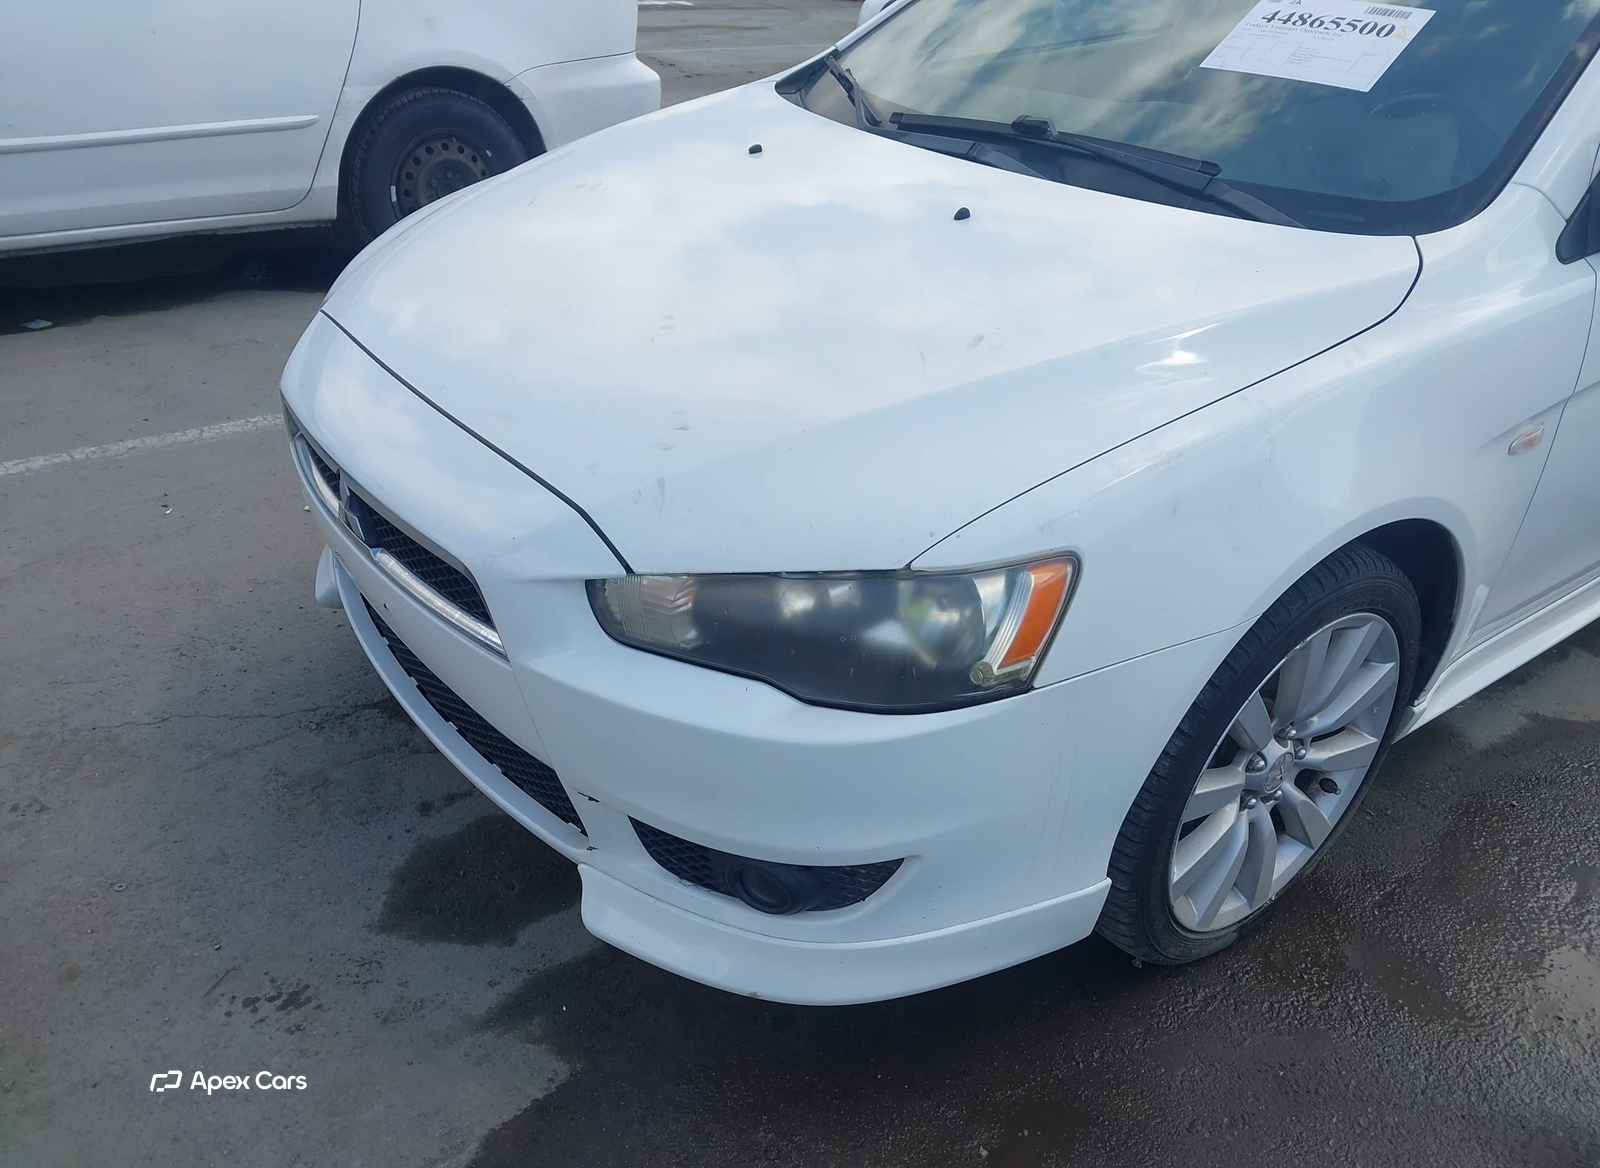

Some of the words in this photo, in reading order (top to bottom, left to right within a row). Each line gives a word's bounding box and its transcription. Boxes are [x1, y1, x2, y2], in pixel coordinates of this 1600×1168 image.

[1261, 10, 1396, 38] 44865500
[1271, 24, 1298, 32] Veterans
[1299, 27, 1331, 36] Outreach
